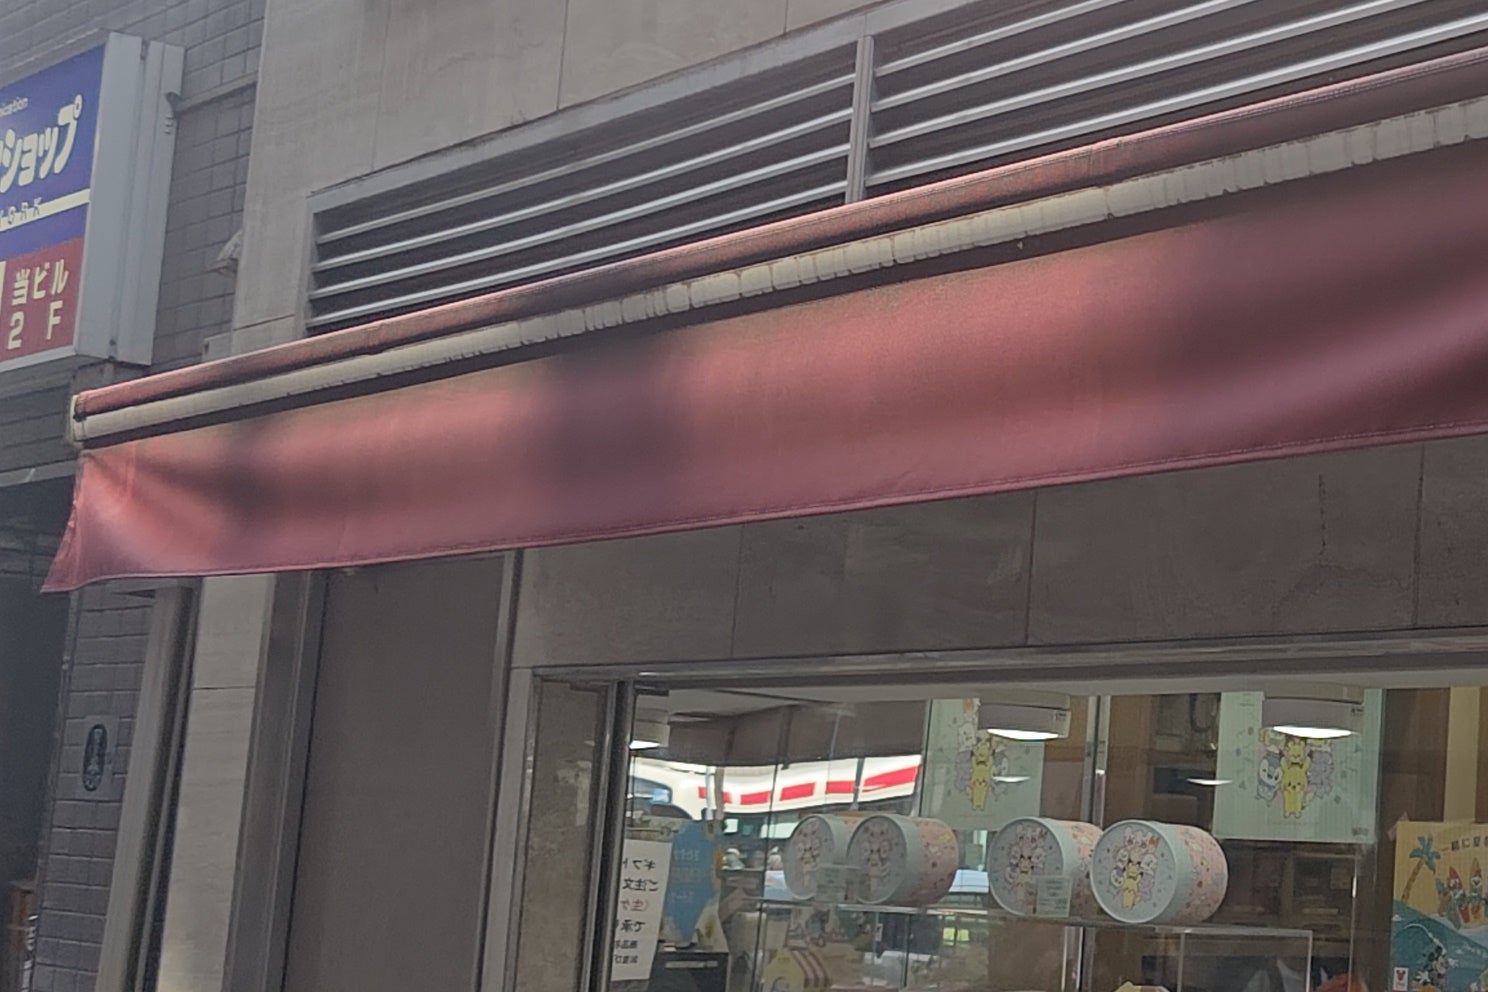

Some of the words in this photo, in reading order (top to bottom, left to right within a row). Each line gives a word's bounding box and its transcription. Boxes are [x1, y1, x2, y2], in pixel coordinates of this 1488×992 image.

[0, 94, 83, 193] ショップ
[12, 258, 69, 305] 当ビル
